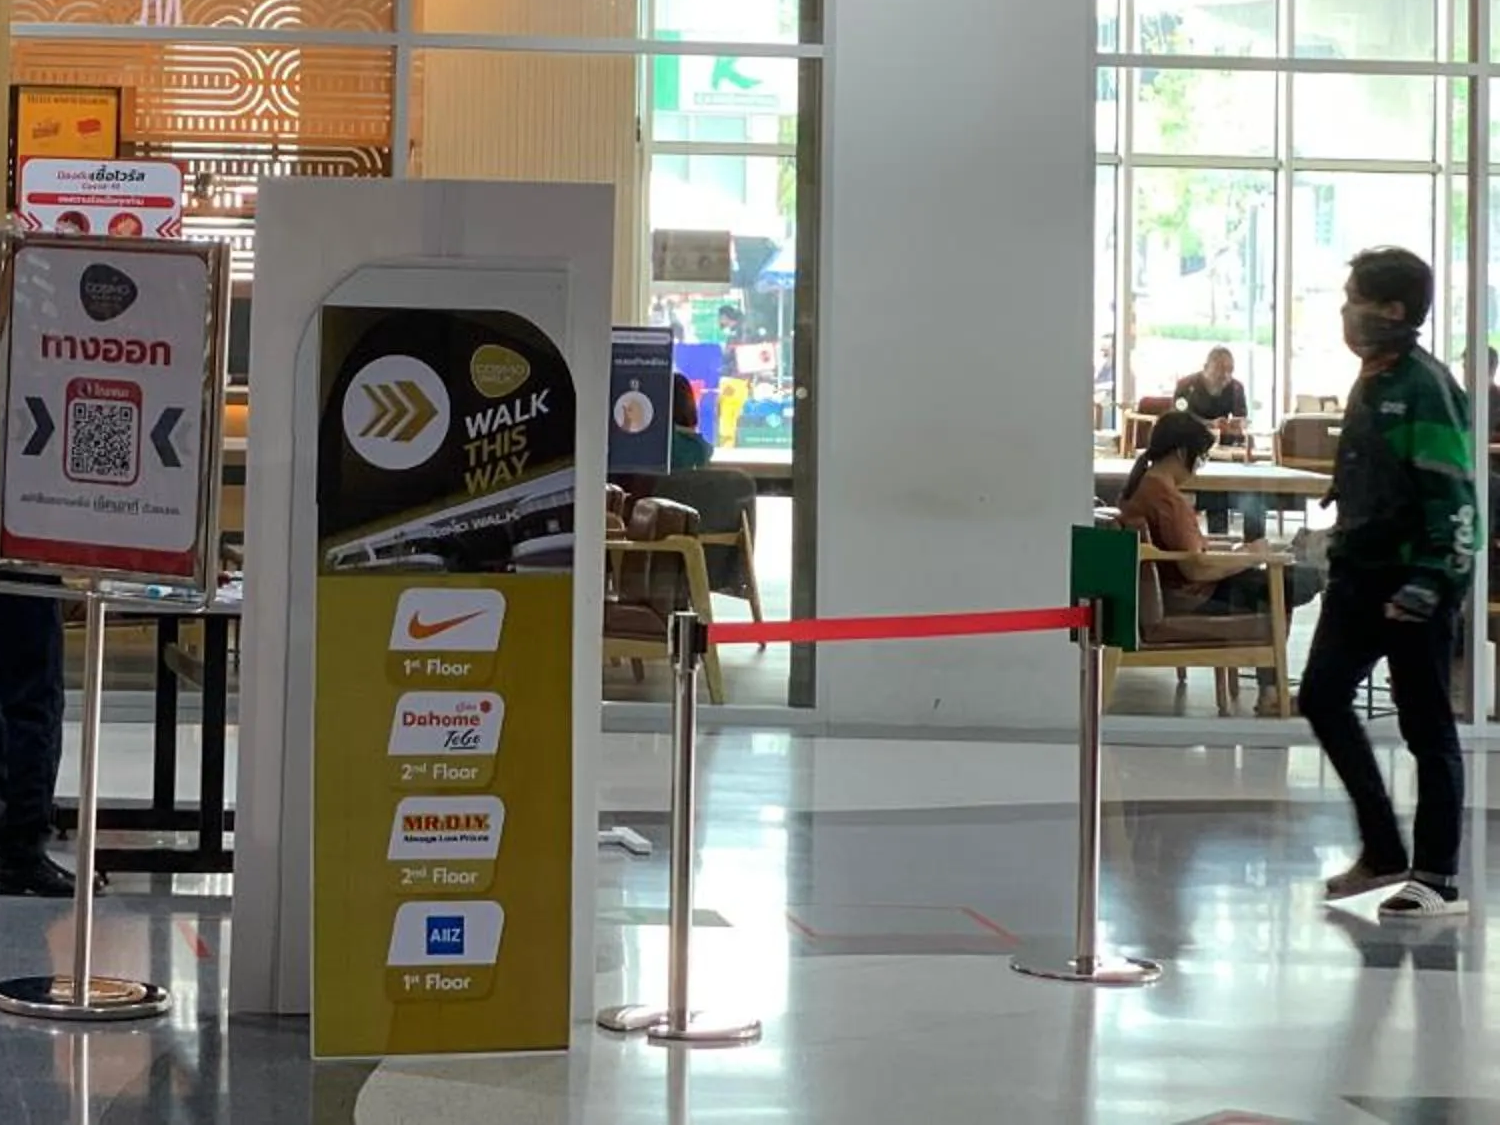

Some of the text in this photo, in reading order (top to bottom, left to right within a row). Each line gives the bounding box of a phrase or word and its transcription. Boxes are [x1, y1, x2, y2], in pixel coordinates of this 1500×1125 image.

[41, 333, 171, 365] ทางออก
[465, 388, 549, 440] WALK
[464, 425, 528, 466] THIS
[464, 452, 530, 496] WAY
[403, 659, 471, 676] 1st Floor
[401, 763, 478, 780] 2nd Floor
[401, 868, 478, 885] 2nd Floor
[403, 974, 471, 991] 1st Floor
